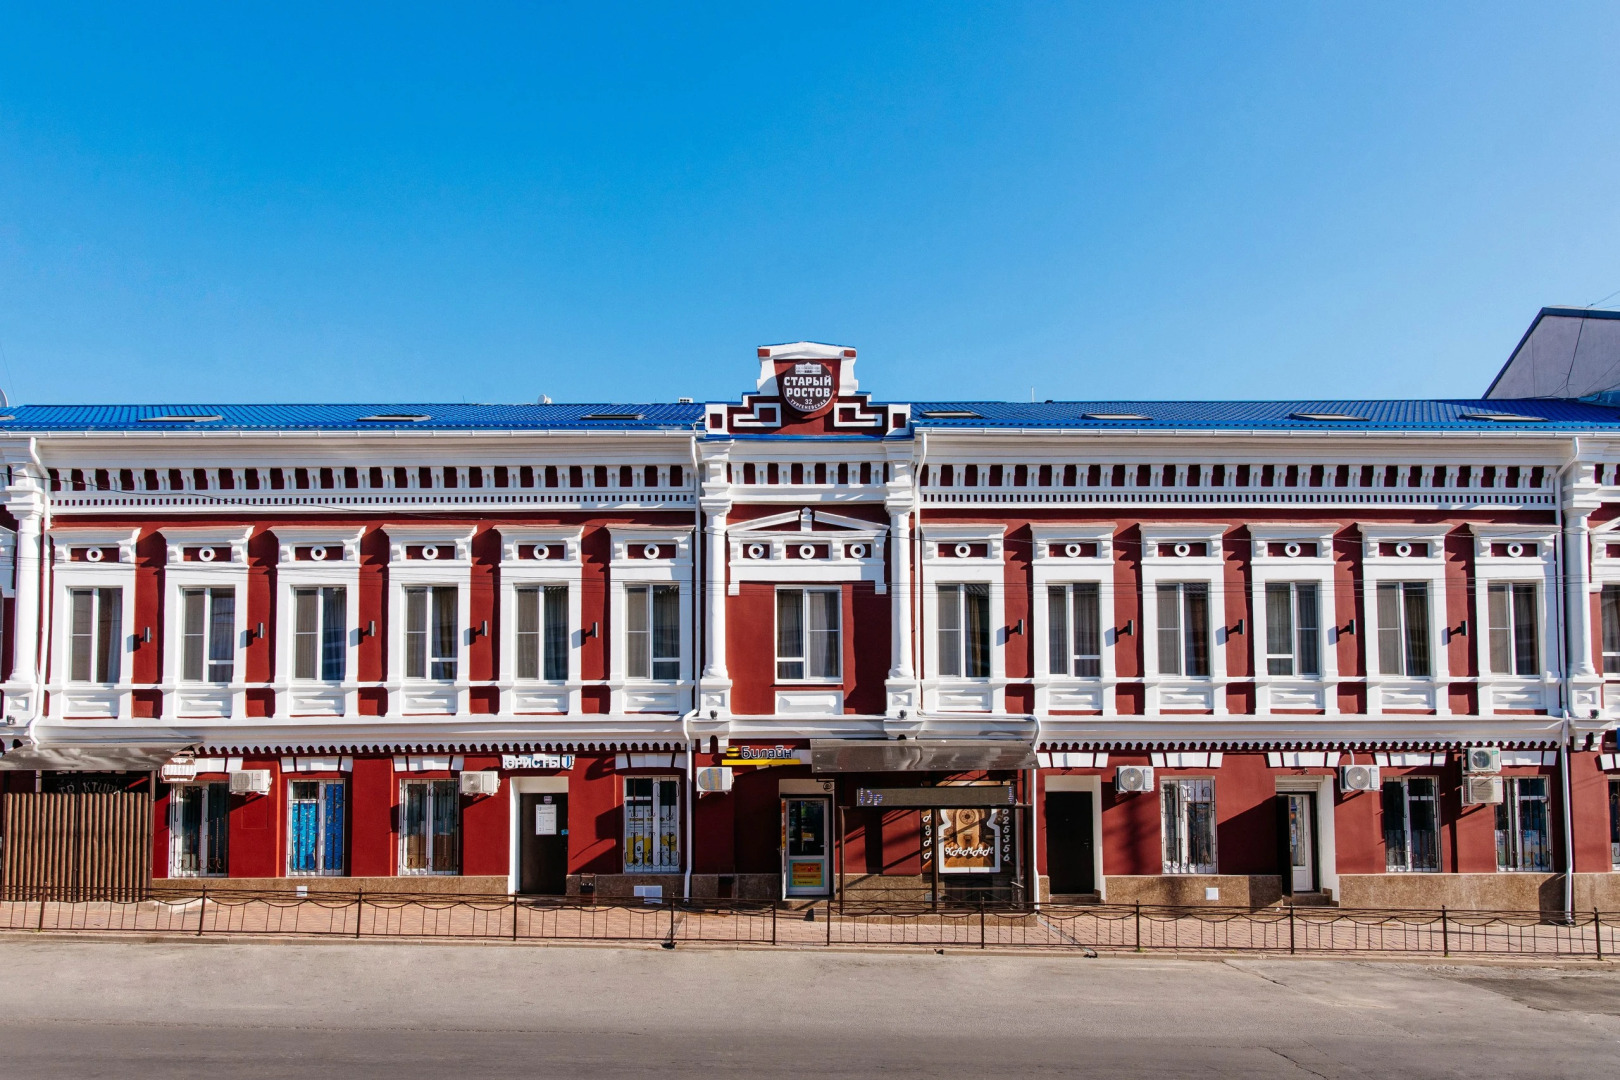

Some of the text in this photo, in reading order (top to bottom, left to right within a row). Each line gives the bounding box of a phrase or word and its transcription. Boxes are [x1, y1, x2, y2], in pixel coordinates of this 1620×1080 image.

[783, 375, 832, 386] СТАРЫЙ
[786, 388, 831, 398] РОСТОВ
[790, 398, 828, 410] ТУРГЕНЕВСКАЯ
[502, 755, 560, 769] ЮРИСТЫ
[944, 846, 995, 857] ХАМАМ
